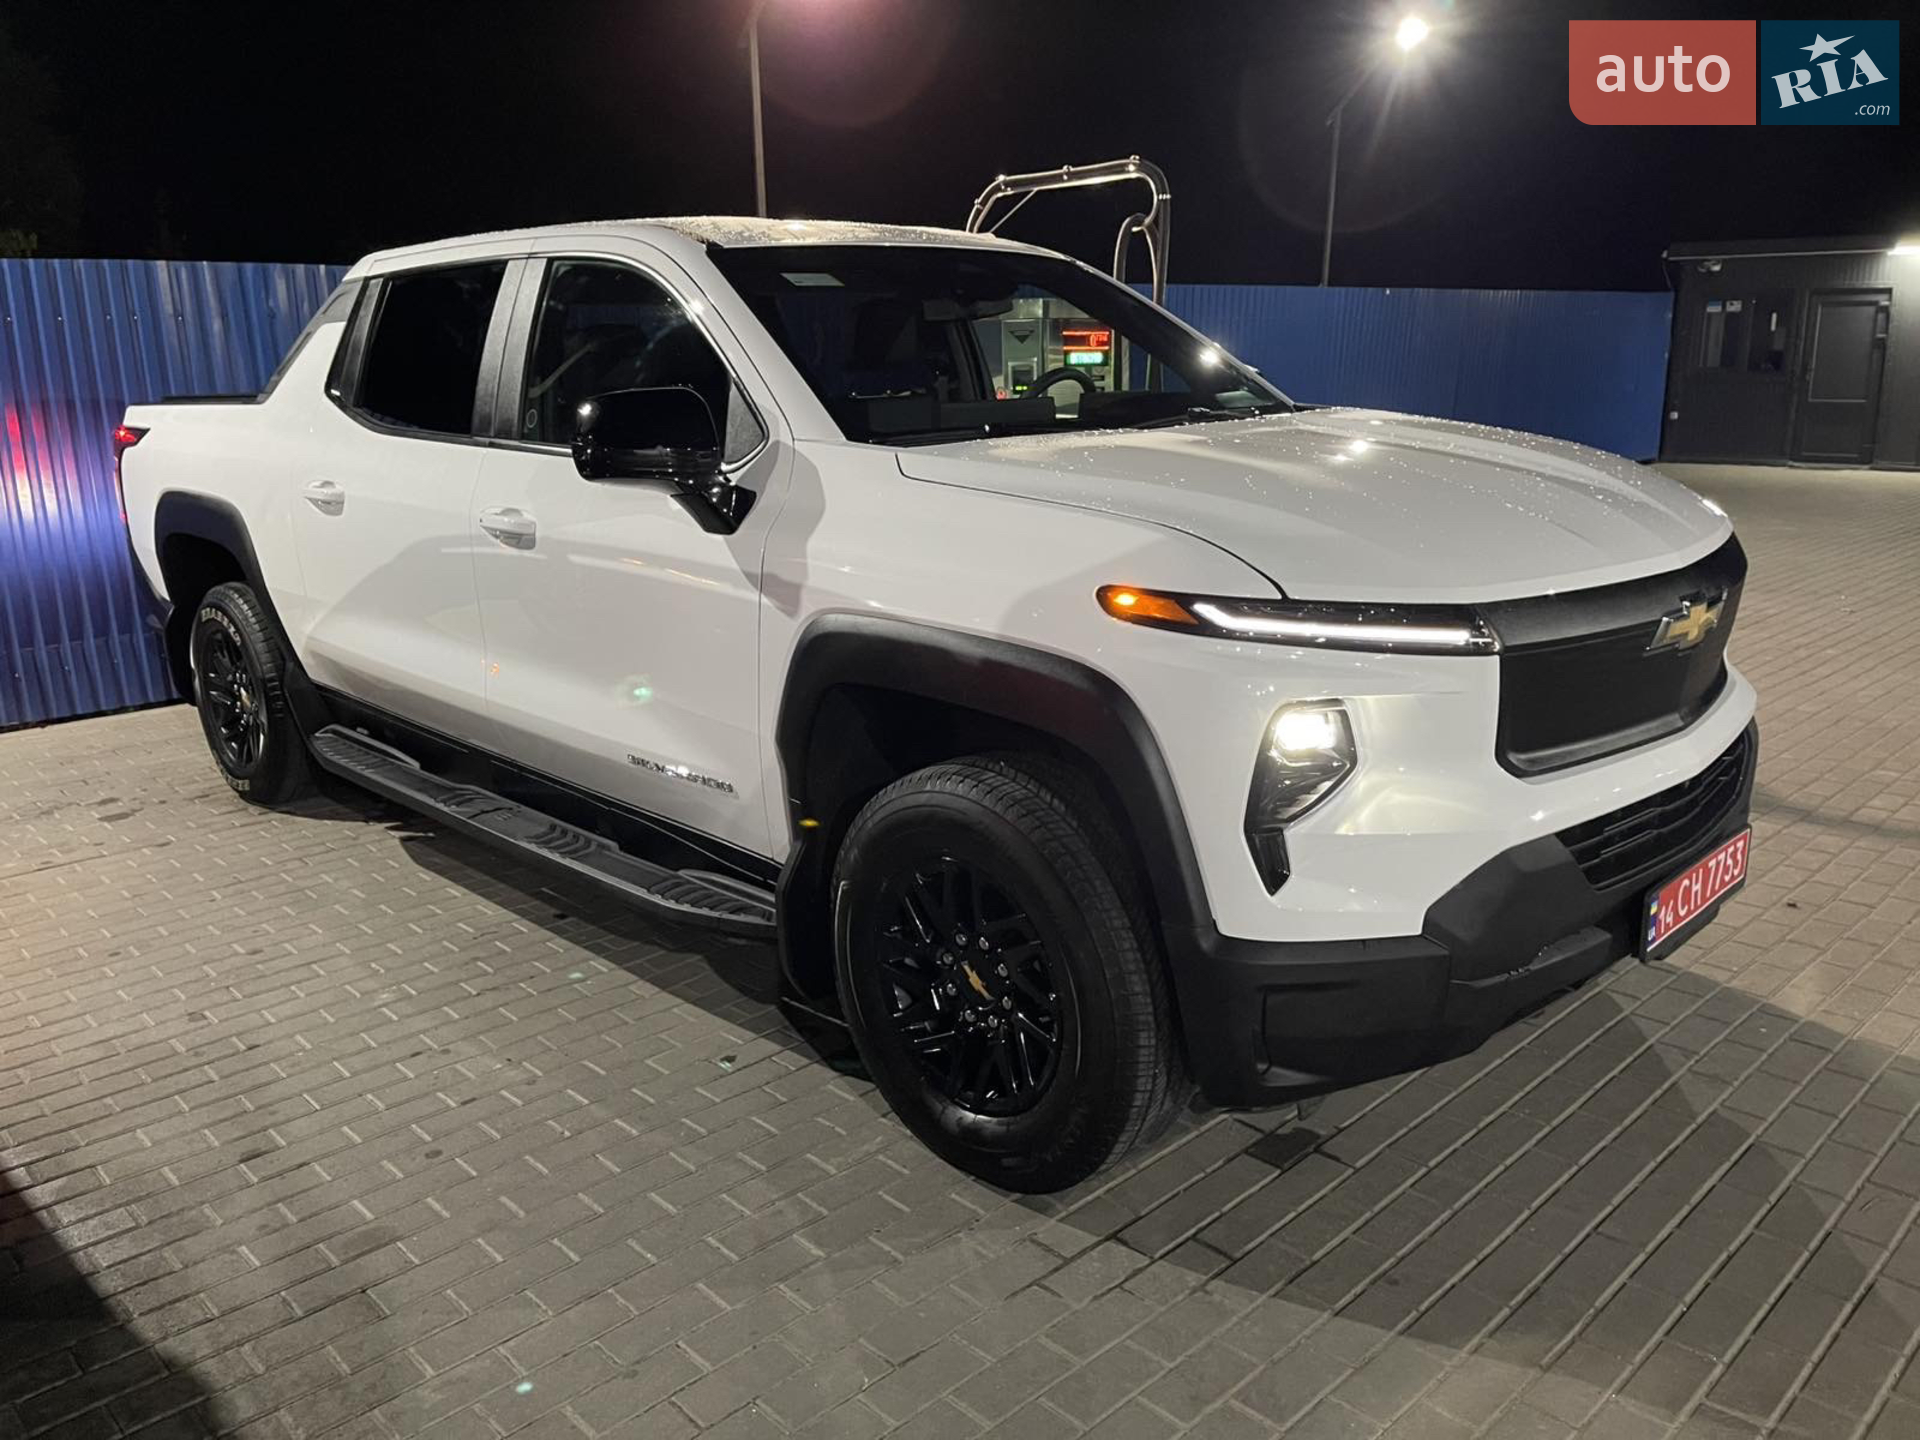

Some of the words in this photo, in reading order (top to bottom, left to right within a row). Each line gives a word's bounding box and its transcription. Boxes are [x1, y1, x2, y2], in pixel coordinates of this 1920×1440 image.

[1659, 899, 1674, 934] 14
[1677, 868, 1703, 917] CH
[1707, 839, 1745, 898] 7753
